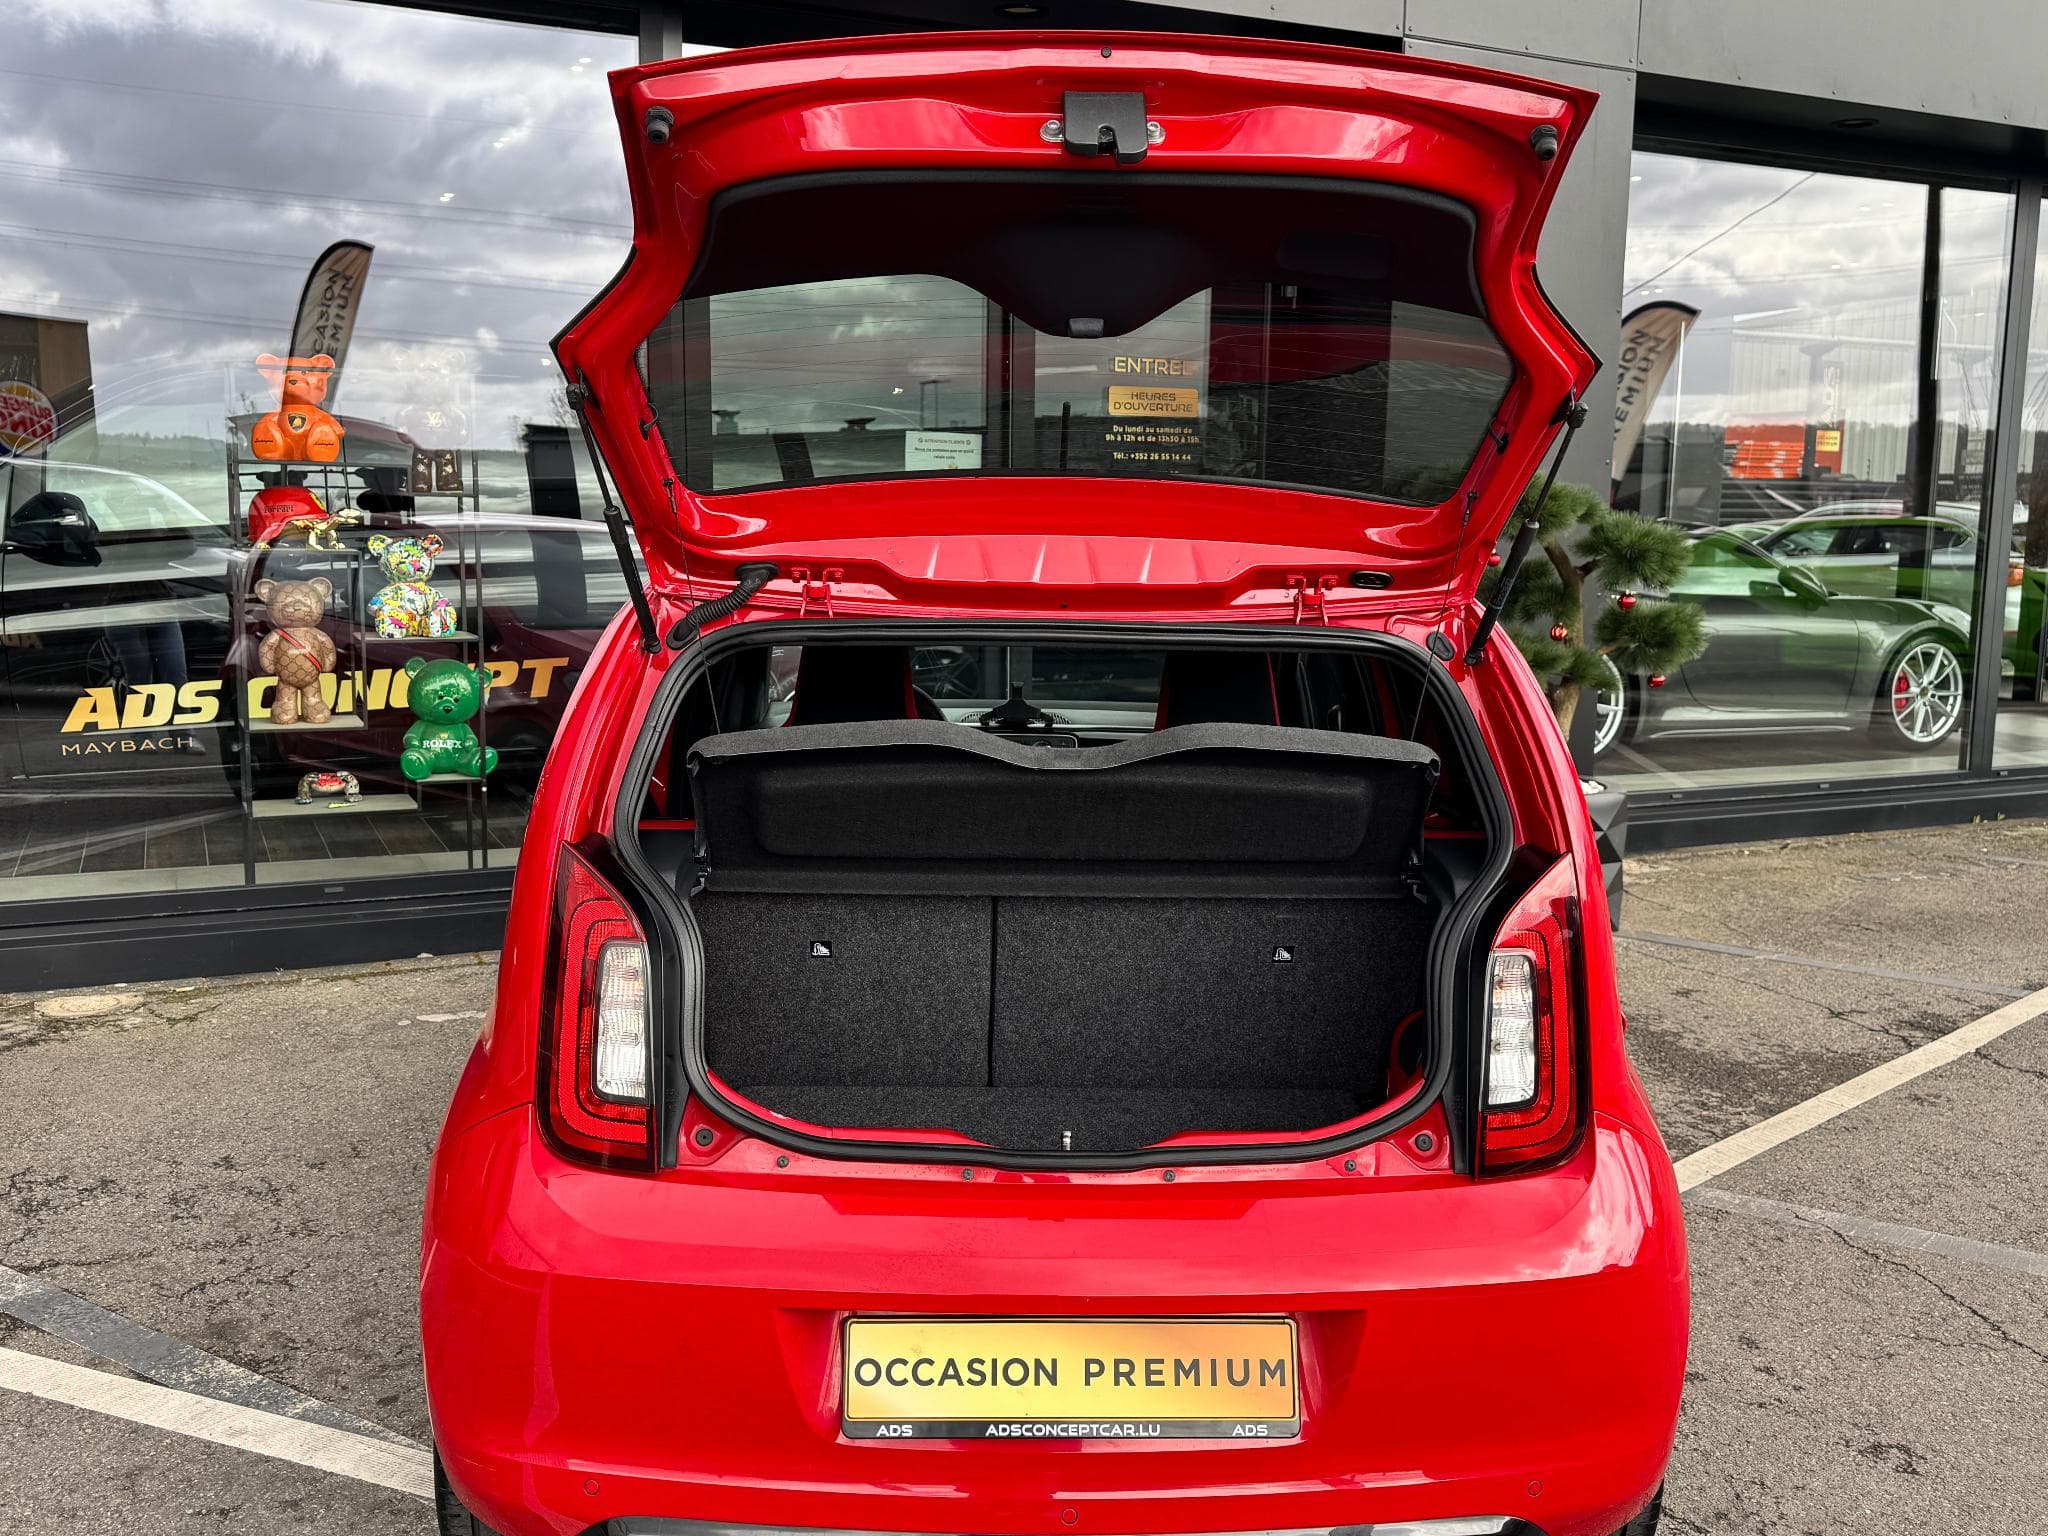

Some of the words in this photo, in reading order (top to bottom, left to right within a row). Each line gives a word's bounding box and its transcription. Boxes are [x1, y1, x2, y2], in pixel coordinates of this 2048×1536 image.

[1130, 391, 1177, 401] HEURES
[1113, 401, 1193, 413] D'OUVERTURE
[1125, 425, 1144, 434] lundi
[60, 679, 223, 733] ADS
[247, 656, 570, 719] CONCPT
[60, 736, 194, 757] MAYBACH
[422, 739, 463, 749] ROLEX
[854, 1357, 1058, 1387] OCCASION
[1084, 1357, 1286, 1387] PREMIUM
[876, 1424, 913, 1437] ADS
[985, 1423, 1161, 1437] ADSCONCEPTCAR.LU
[1231, 1424, 1268, 1437] ADS
